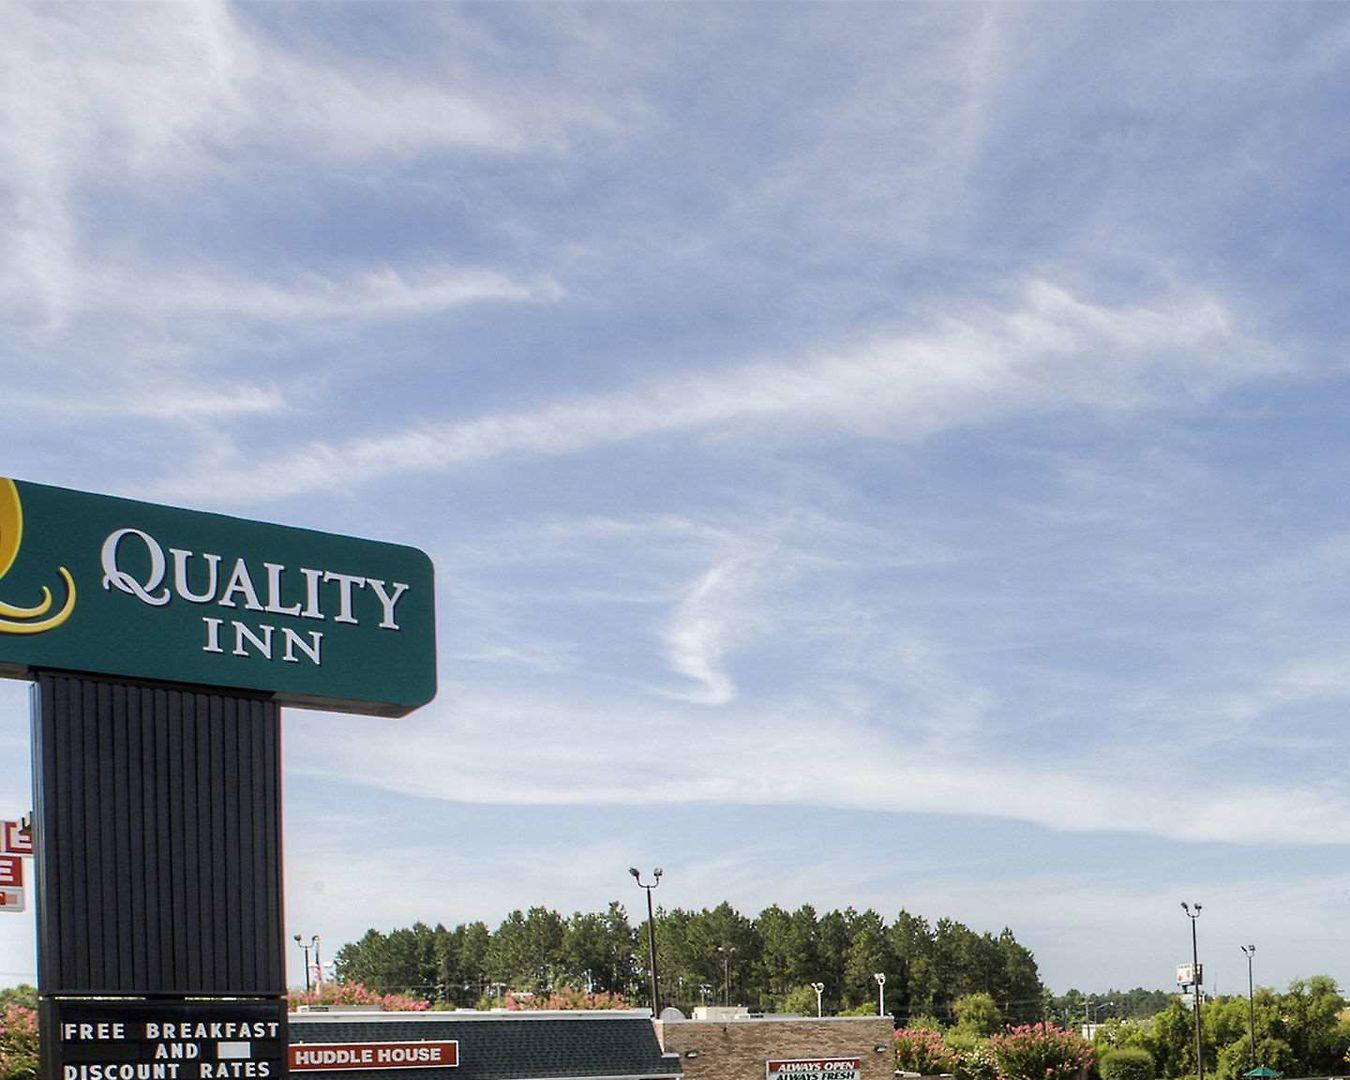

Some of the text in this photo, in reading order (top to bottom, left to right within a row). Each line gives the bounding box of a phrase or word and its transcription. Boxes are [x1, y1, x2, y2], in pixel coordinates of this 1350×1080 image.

[100, 528, 410, 630] QUALITY
[202, 617, 323, 665] INN
[64, 1022, 279, 1040] FREE BREAKFAST
[155, 1043, 199, 1059] AND
[295, 1048, 442, 1065] HUDDLE HOUSE
[64, 1061, 270, 1080] DISCOUNT RATES
[778, 1061, 855, 1072] ALWAYS OPEN
[821, 1071, 855, 1080] FRESH
